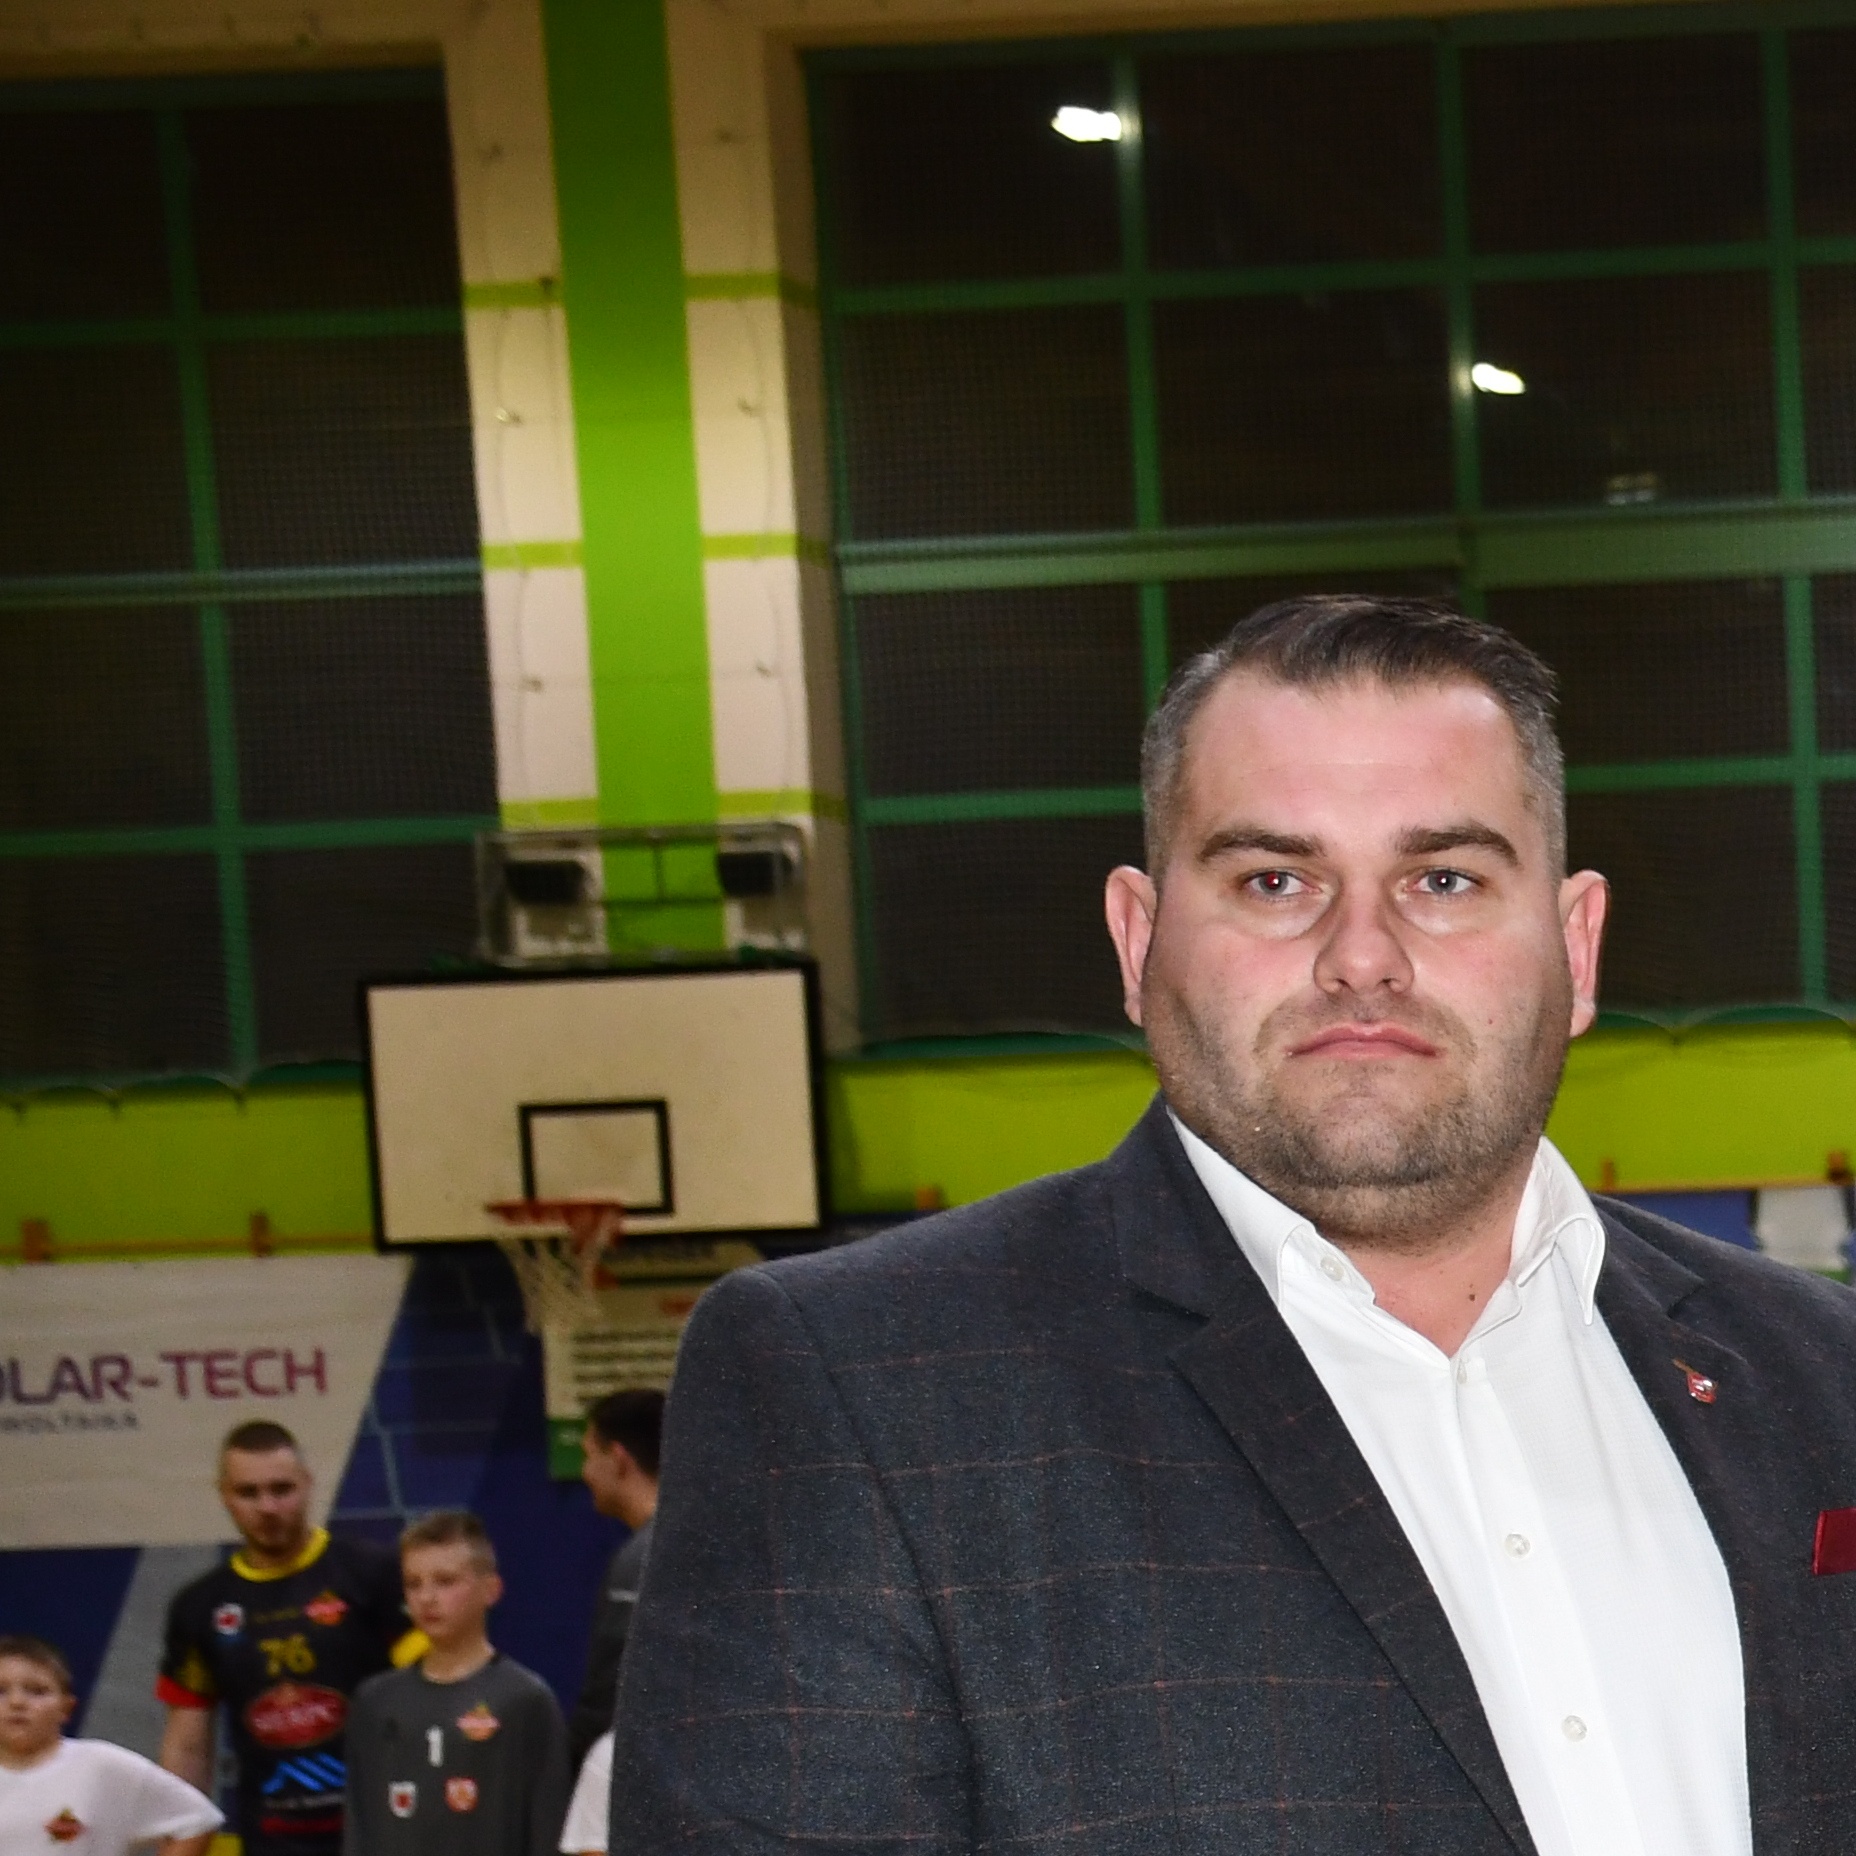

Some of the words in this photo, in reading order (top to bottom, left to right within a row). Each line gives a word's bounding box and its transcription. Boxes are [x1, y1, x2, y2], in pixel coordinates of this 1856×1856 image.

[0, 1348, 326, 1405] LAR-TECH
[259, 1633, 317, 1675] 76
[426, 1724, 444, 1767] 1
